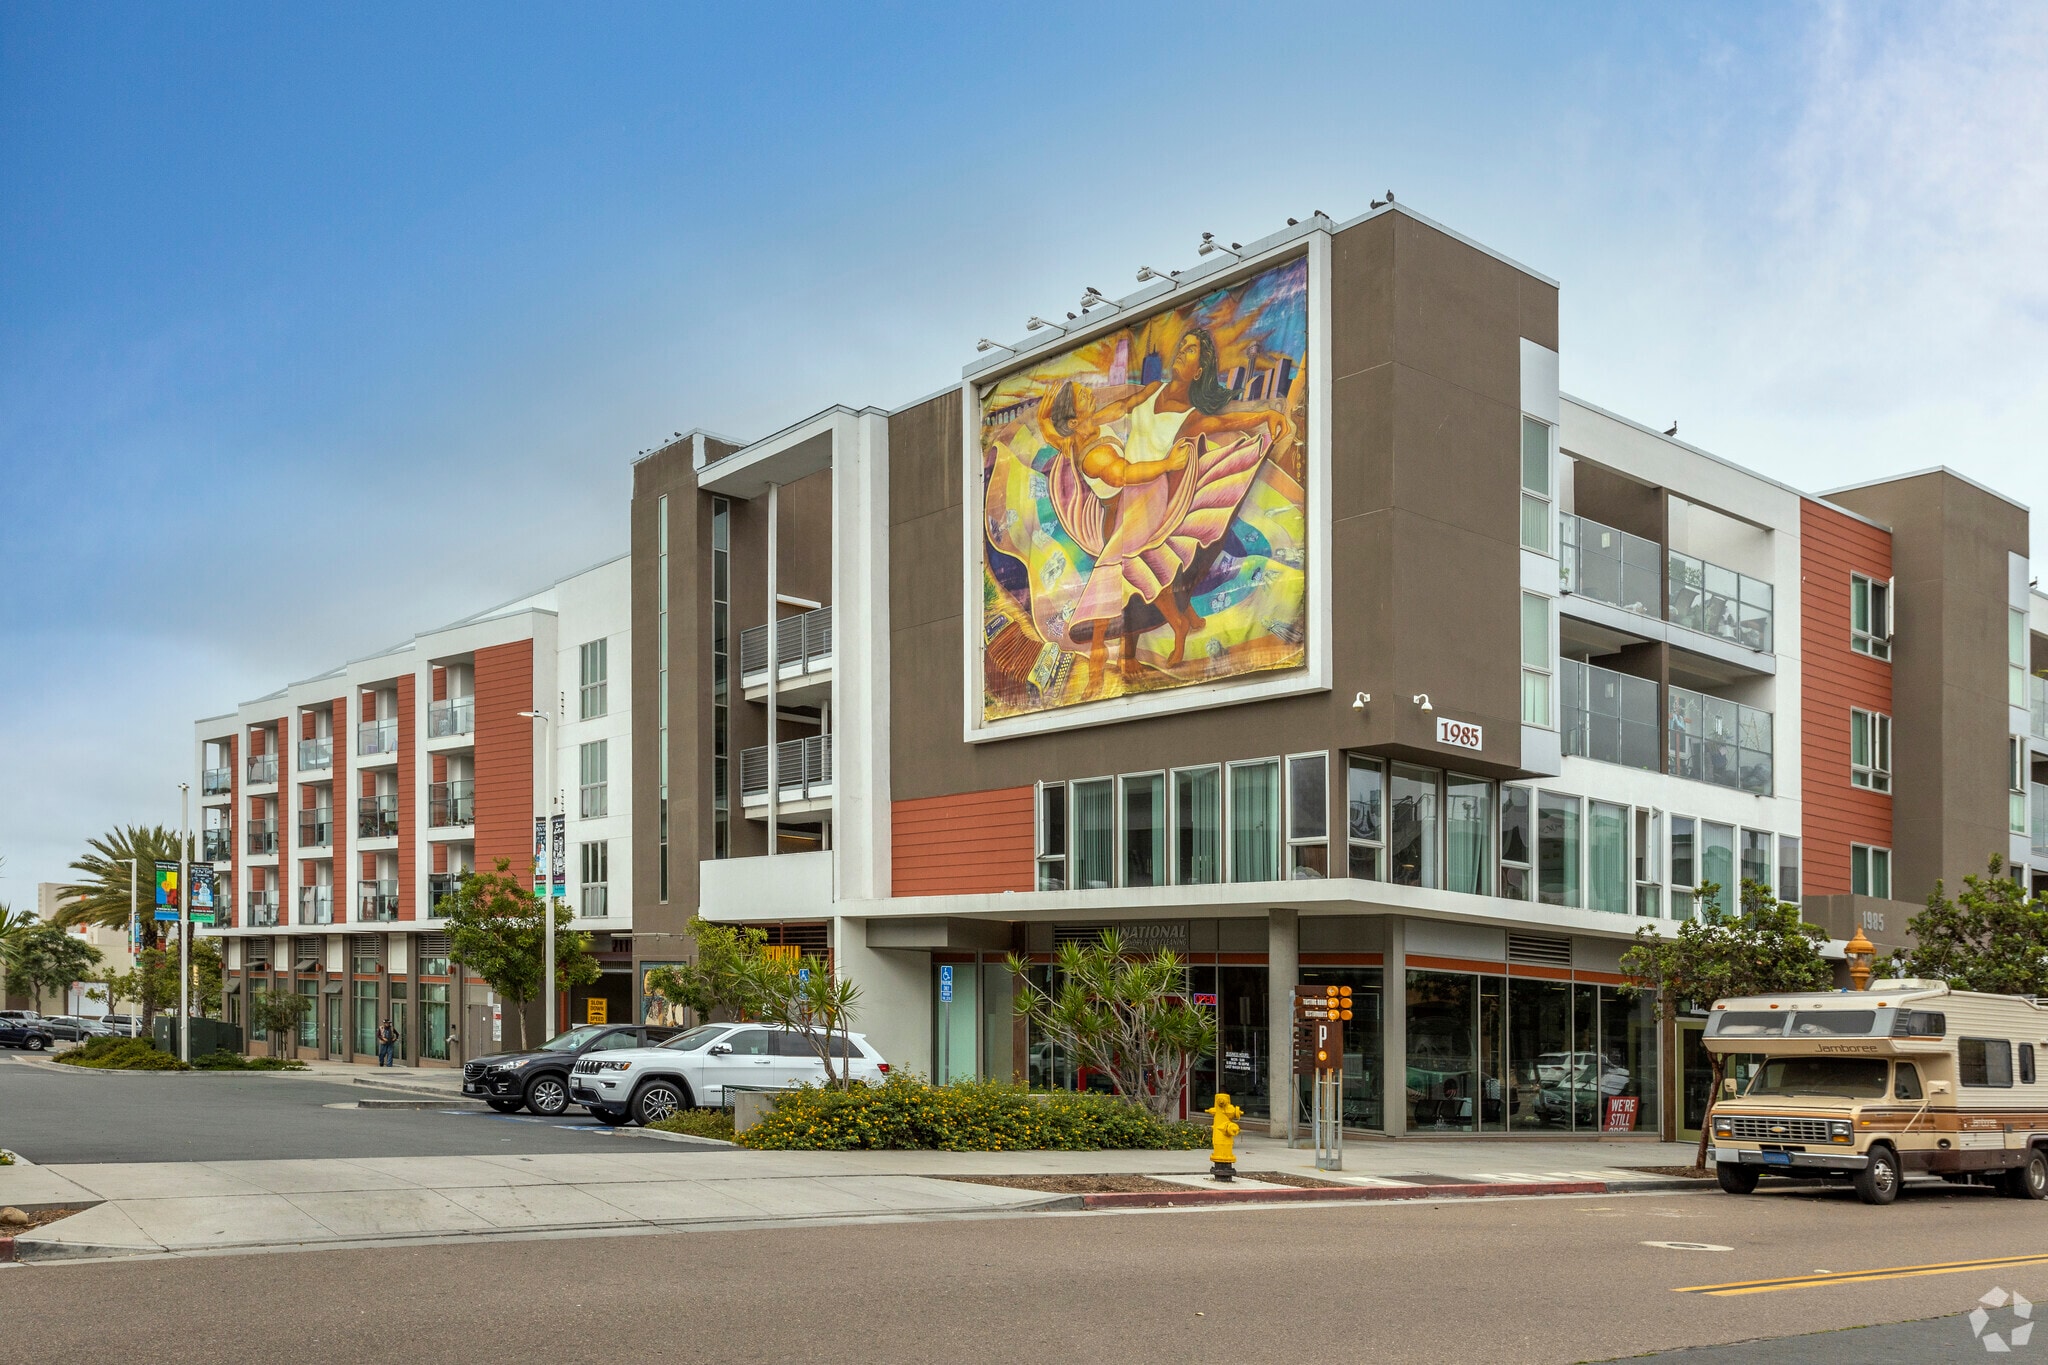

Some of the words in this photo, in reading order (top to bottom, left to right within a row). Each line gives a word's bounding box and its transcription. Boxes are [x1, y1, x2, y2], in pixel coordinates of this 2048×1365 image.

[1441, 722, 1479, 747] 1985
[1862, 911, 1884, 931] 1985
[1120, 925, 1185, 938] NATIONAL
[1195, 995, 1216, 1004] OPEN
[1319, 1025, 1327, 1048] P
[1815, 1043, 1878, 1053] Jamboree
[1611, 1099, 1635, 1112] WE'RE
[1610, 1113, 1630, 1126] STILL
